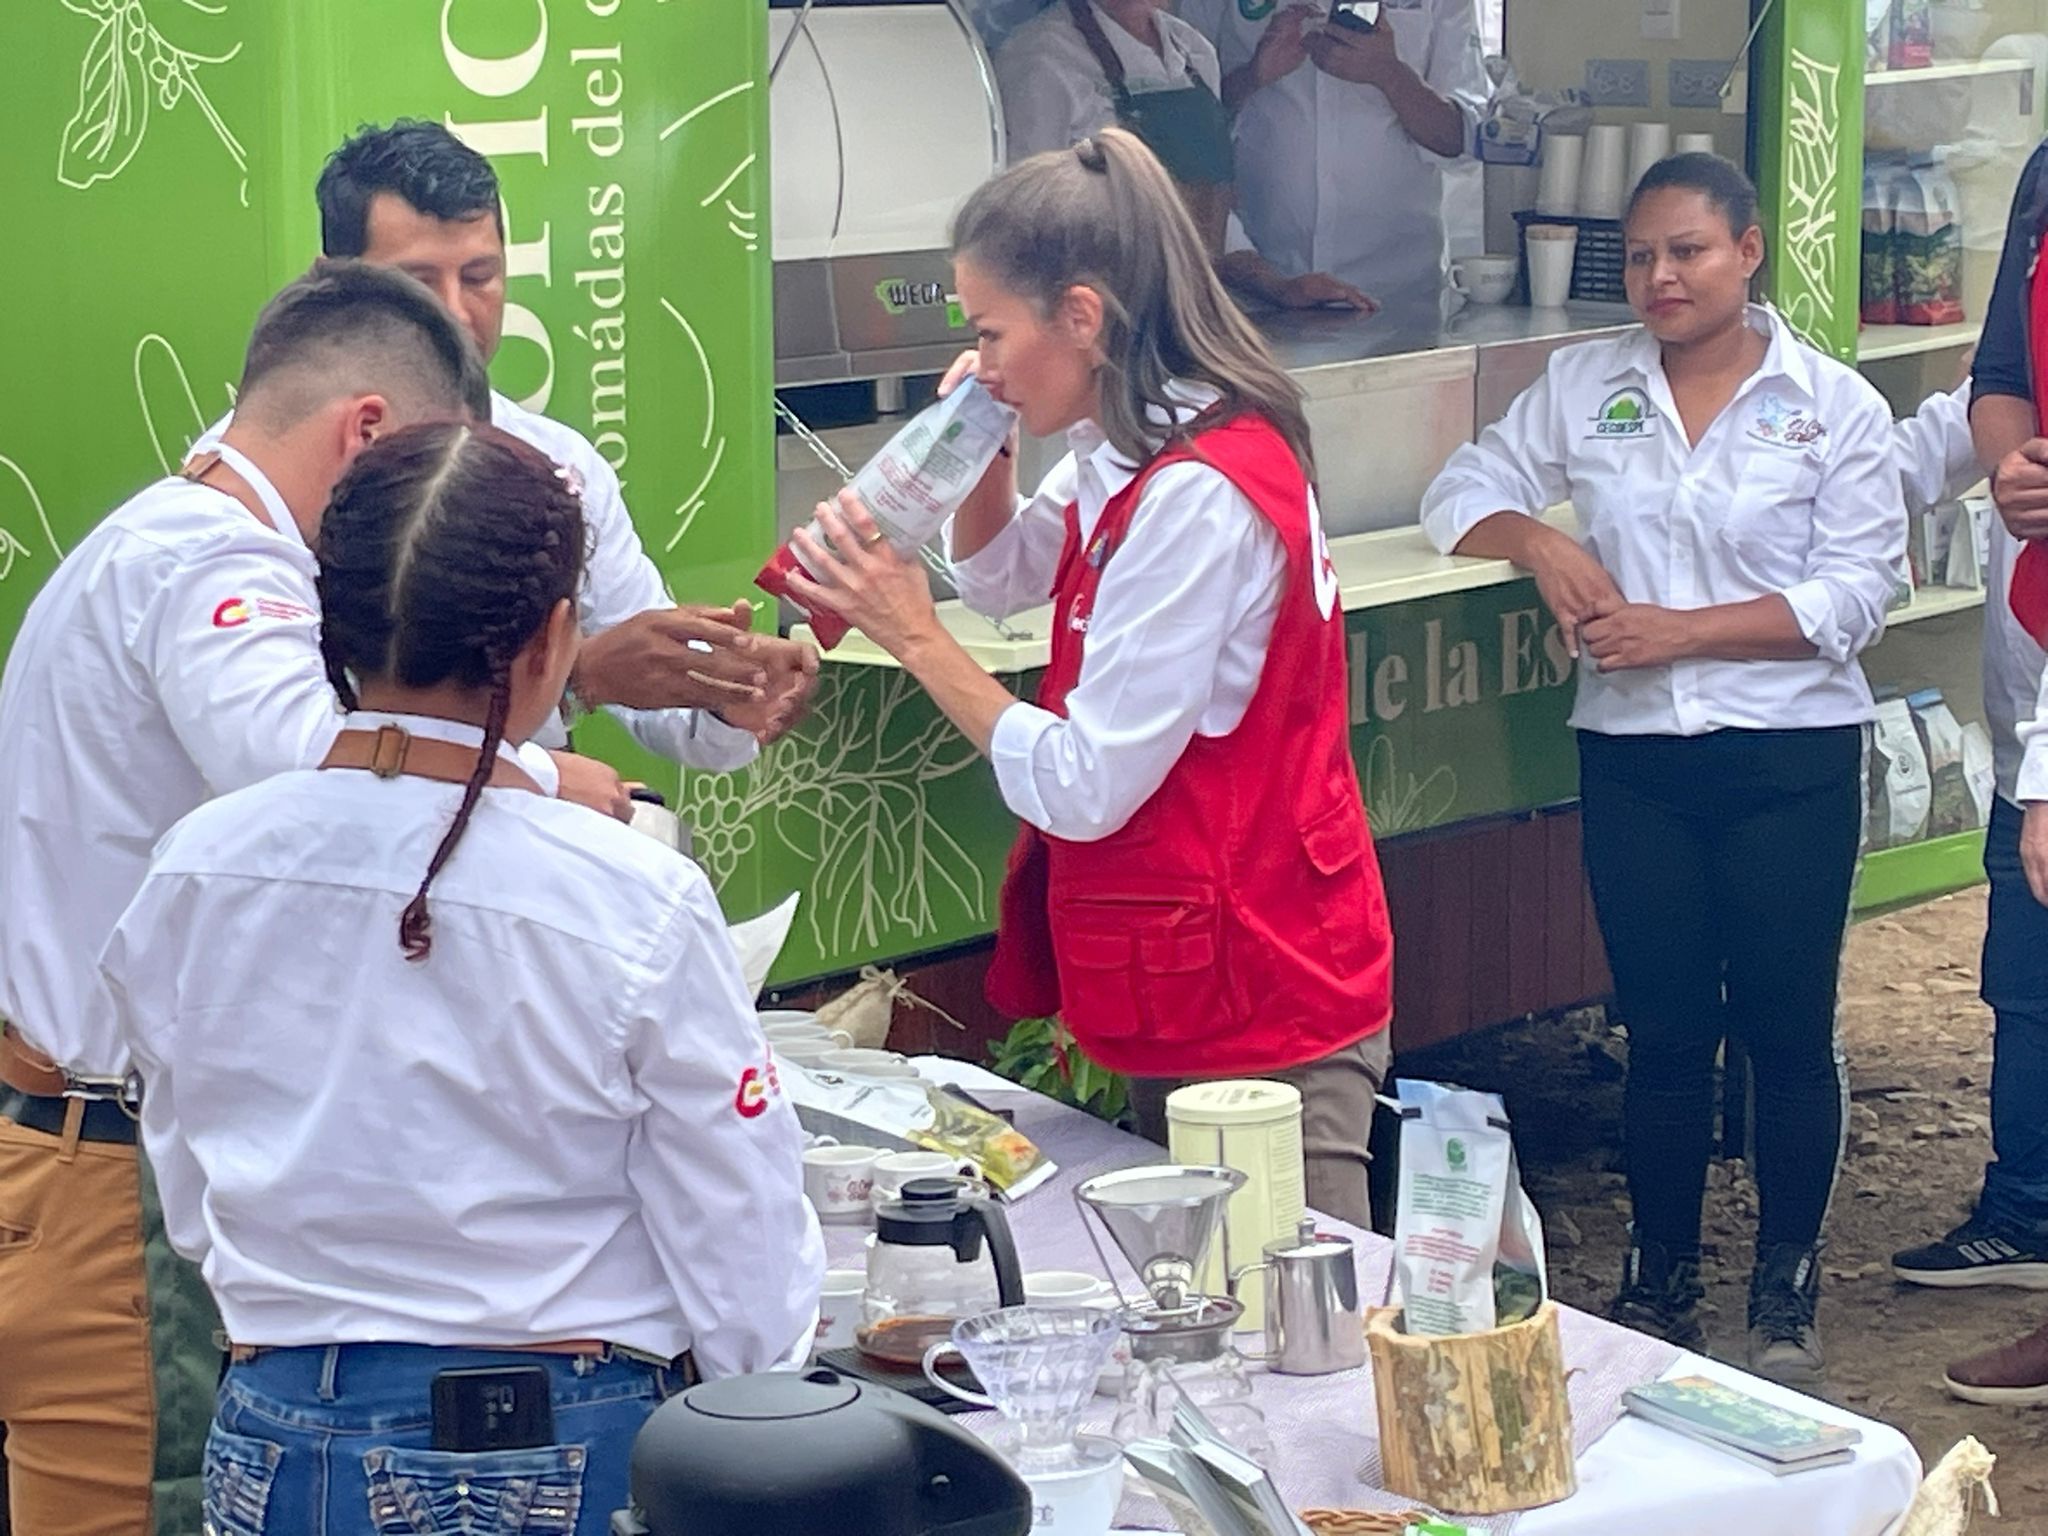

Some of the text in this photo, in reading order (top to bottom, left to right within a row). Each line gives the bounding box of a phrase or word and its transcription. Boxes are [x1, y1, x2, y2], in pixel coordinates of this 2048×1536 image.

[570, 41, 625, 157] del
[572, 182, 628, 489] omádas
[1423, 618, 1480, 714] la
